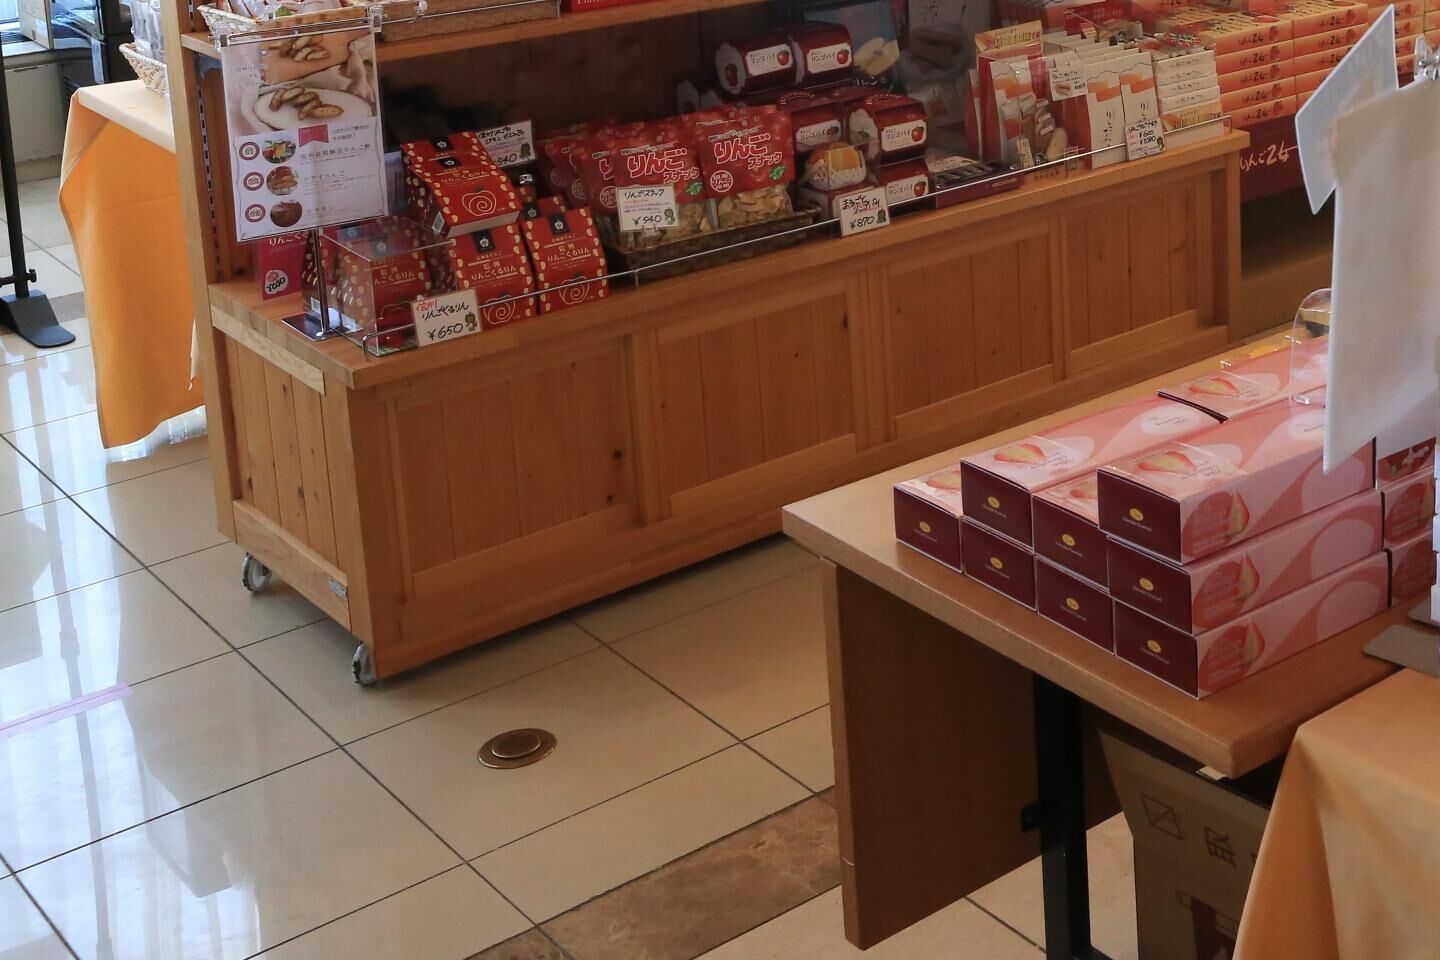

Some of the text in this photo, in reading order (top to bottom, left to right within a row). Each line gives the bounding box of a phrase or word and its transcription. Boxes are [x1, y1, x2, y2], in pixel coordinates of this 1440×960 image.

[714, 133, 770, 164] りんご
[748, 151, 782, 169] スナック
[627, 148, 687, 178] りんご
[664, 168, 699, 184] スナック
